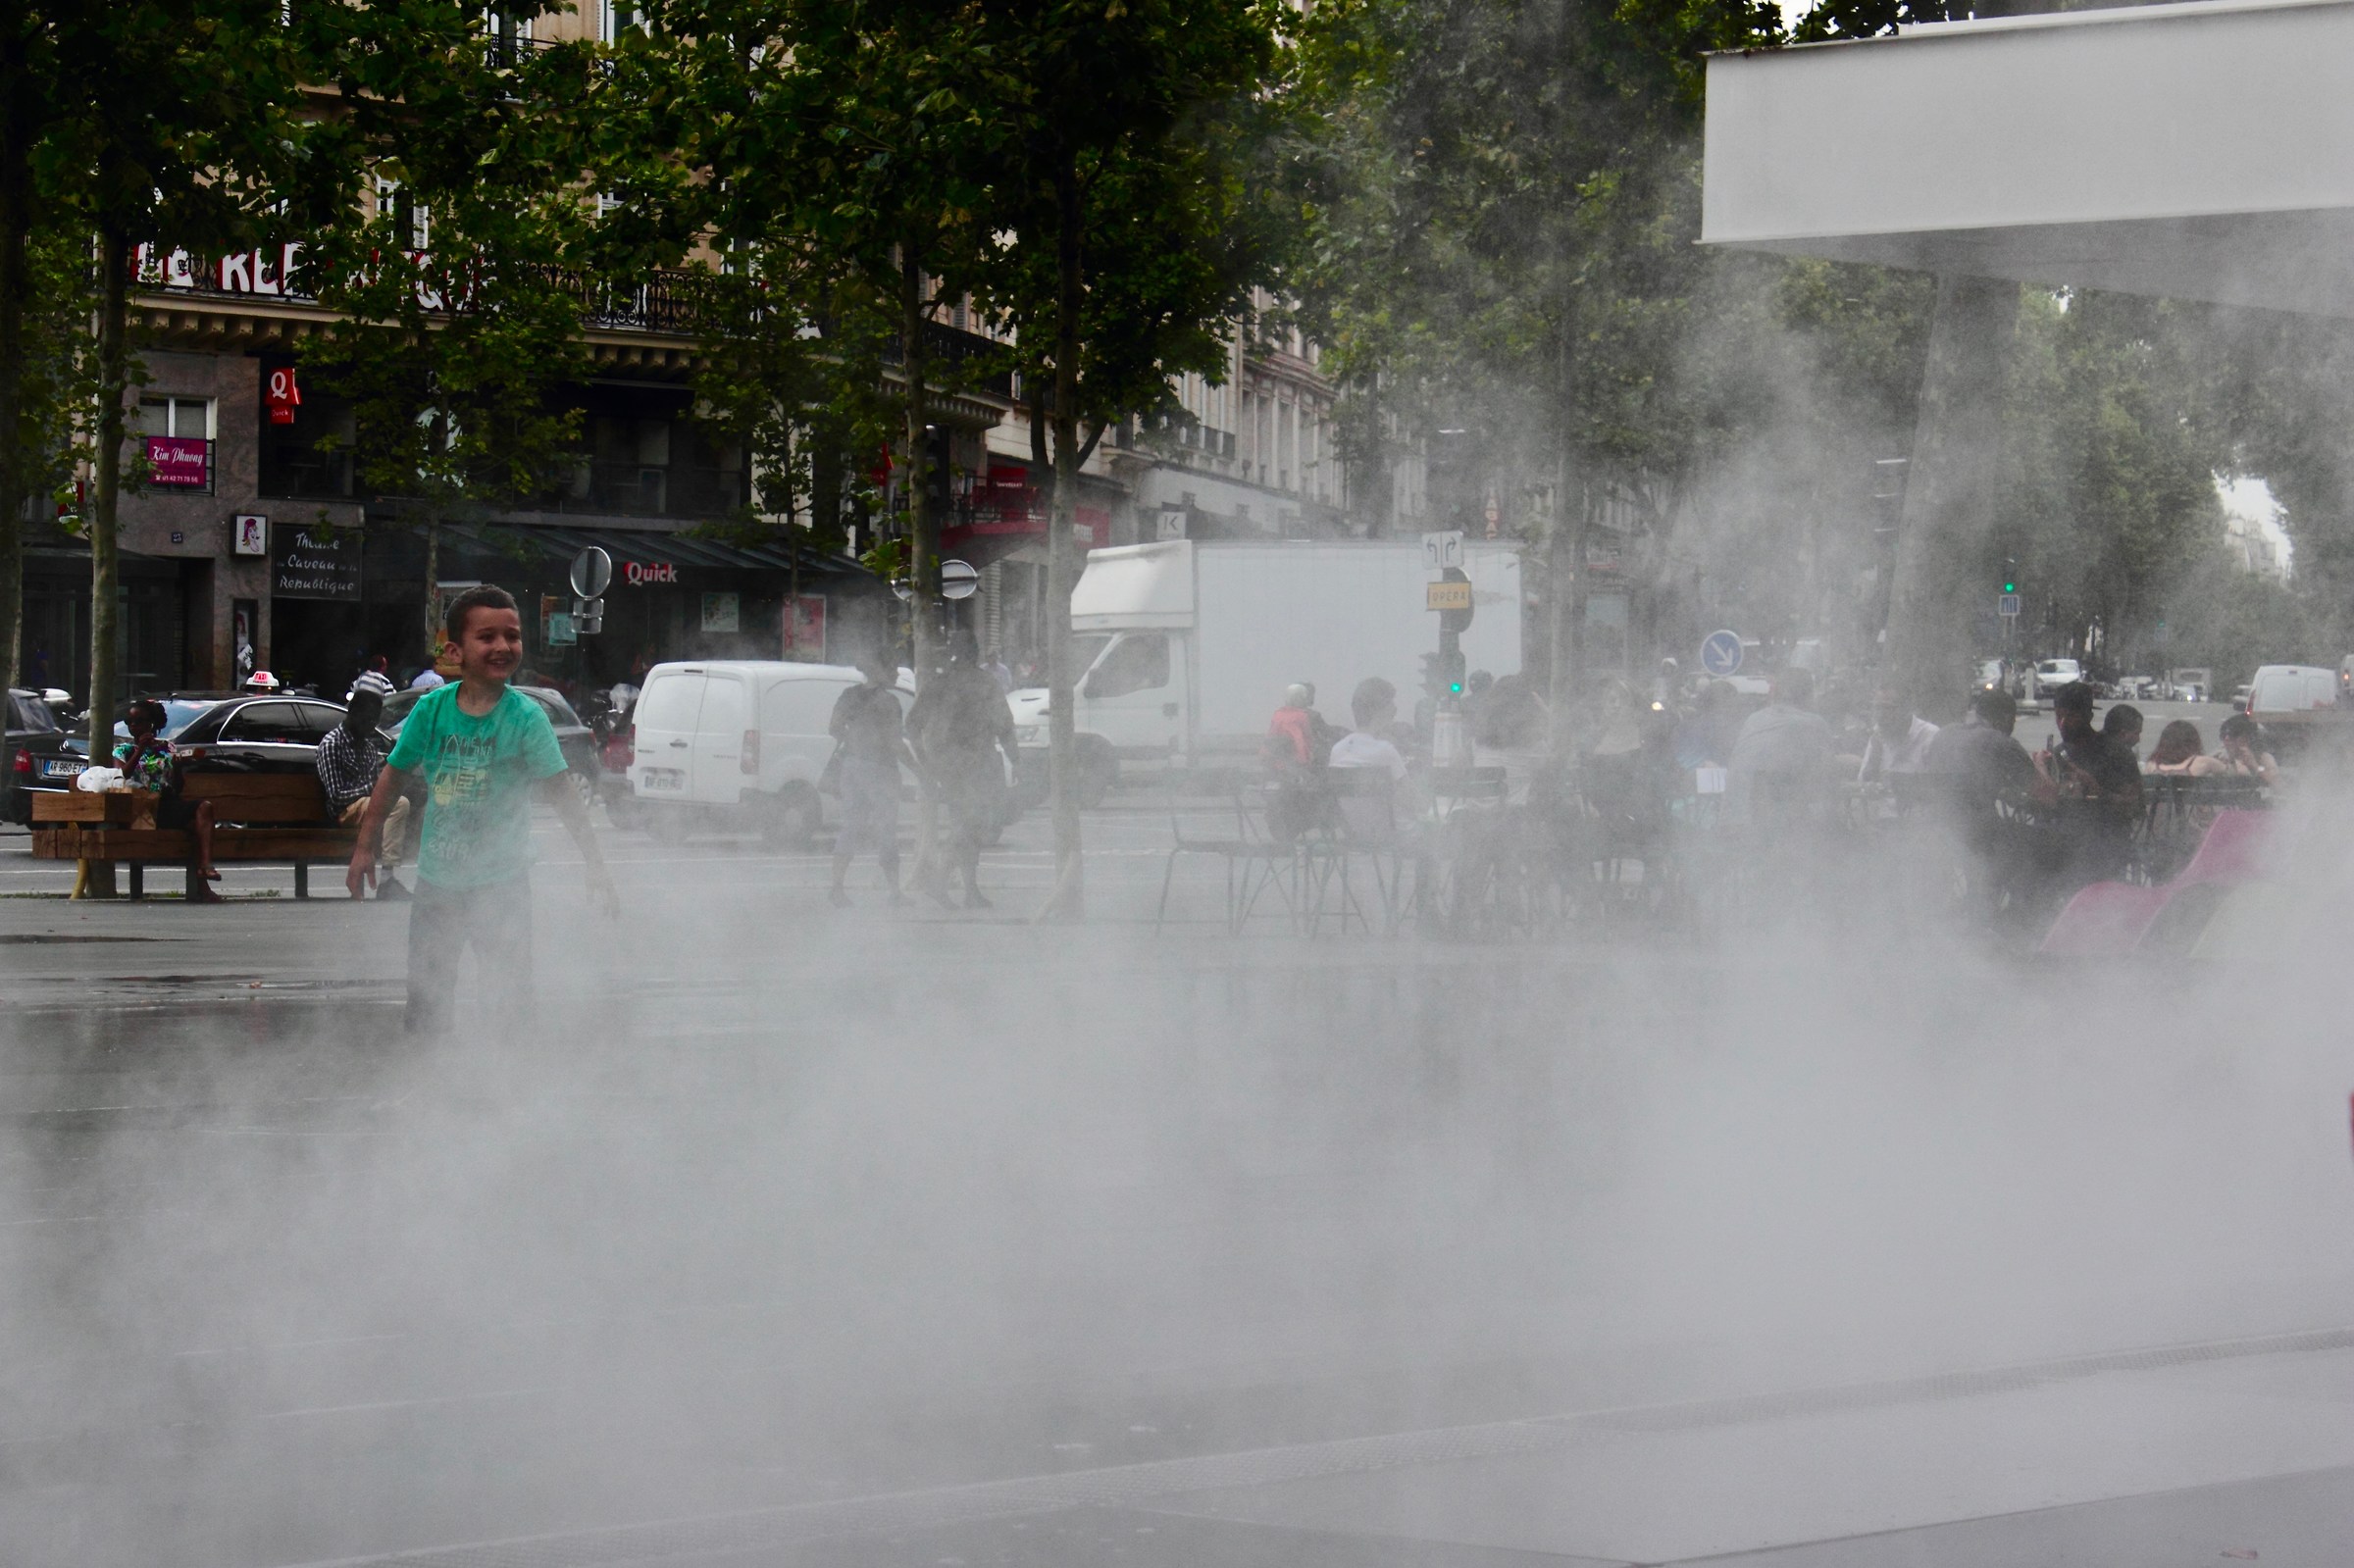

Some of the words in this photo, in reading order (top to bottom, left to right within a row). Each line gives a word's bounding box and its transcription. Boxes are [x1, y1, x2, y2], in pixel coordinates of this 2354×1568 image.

[271, 372, 287, 399] Q
[151, 446, 170, 461] Kim
[287, 554, 335, 570] Caveau
[625, 562, 678, 586] Quick
